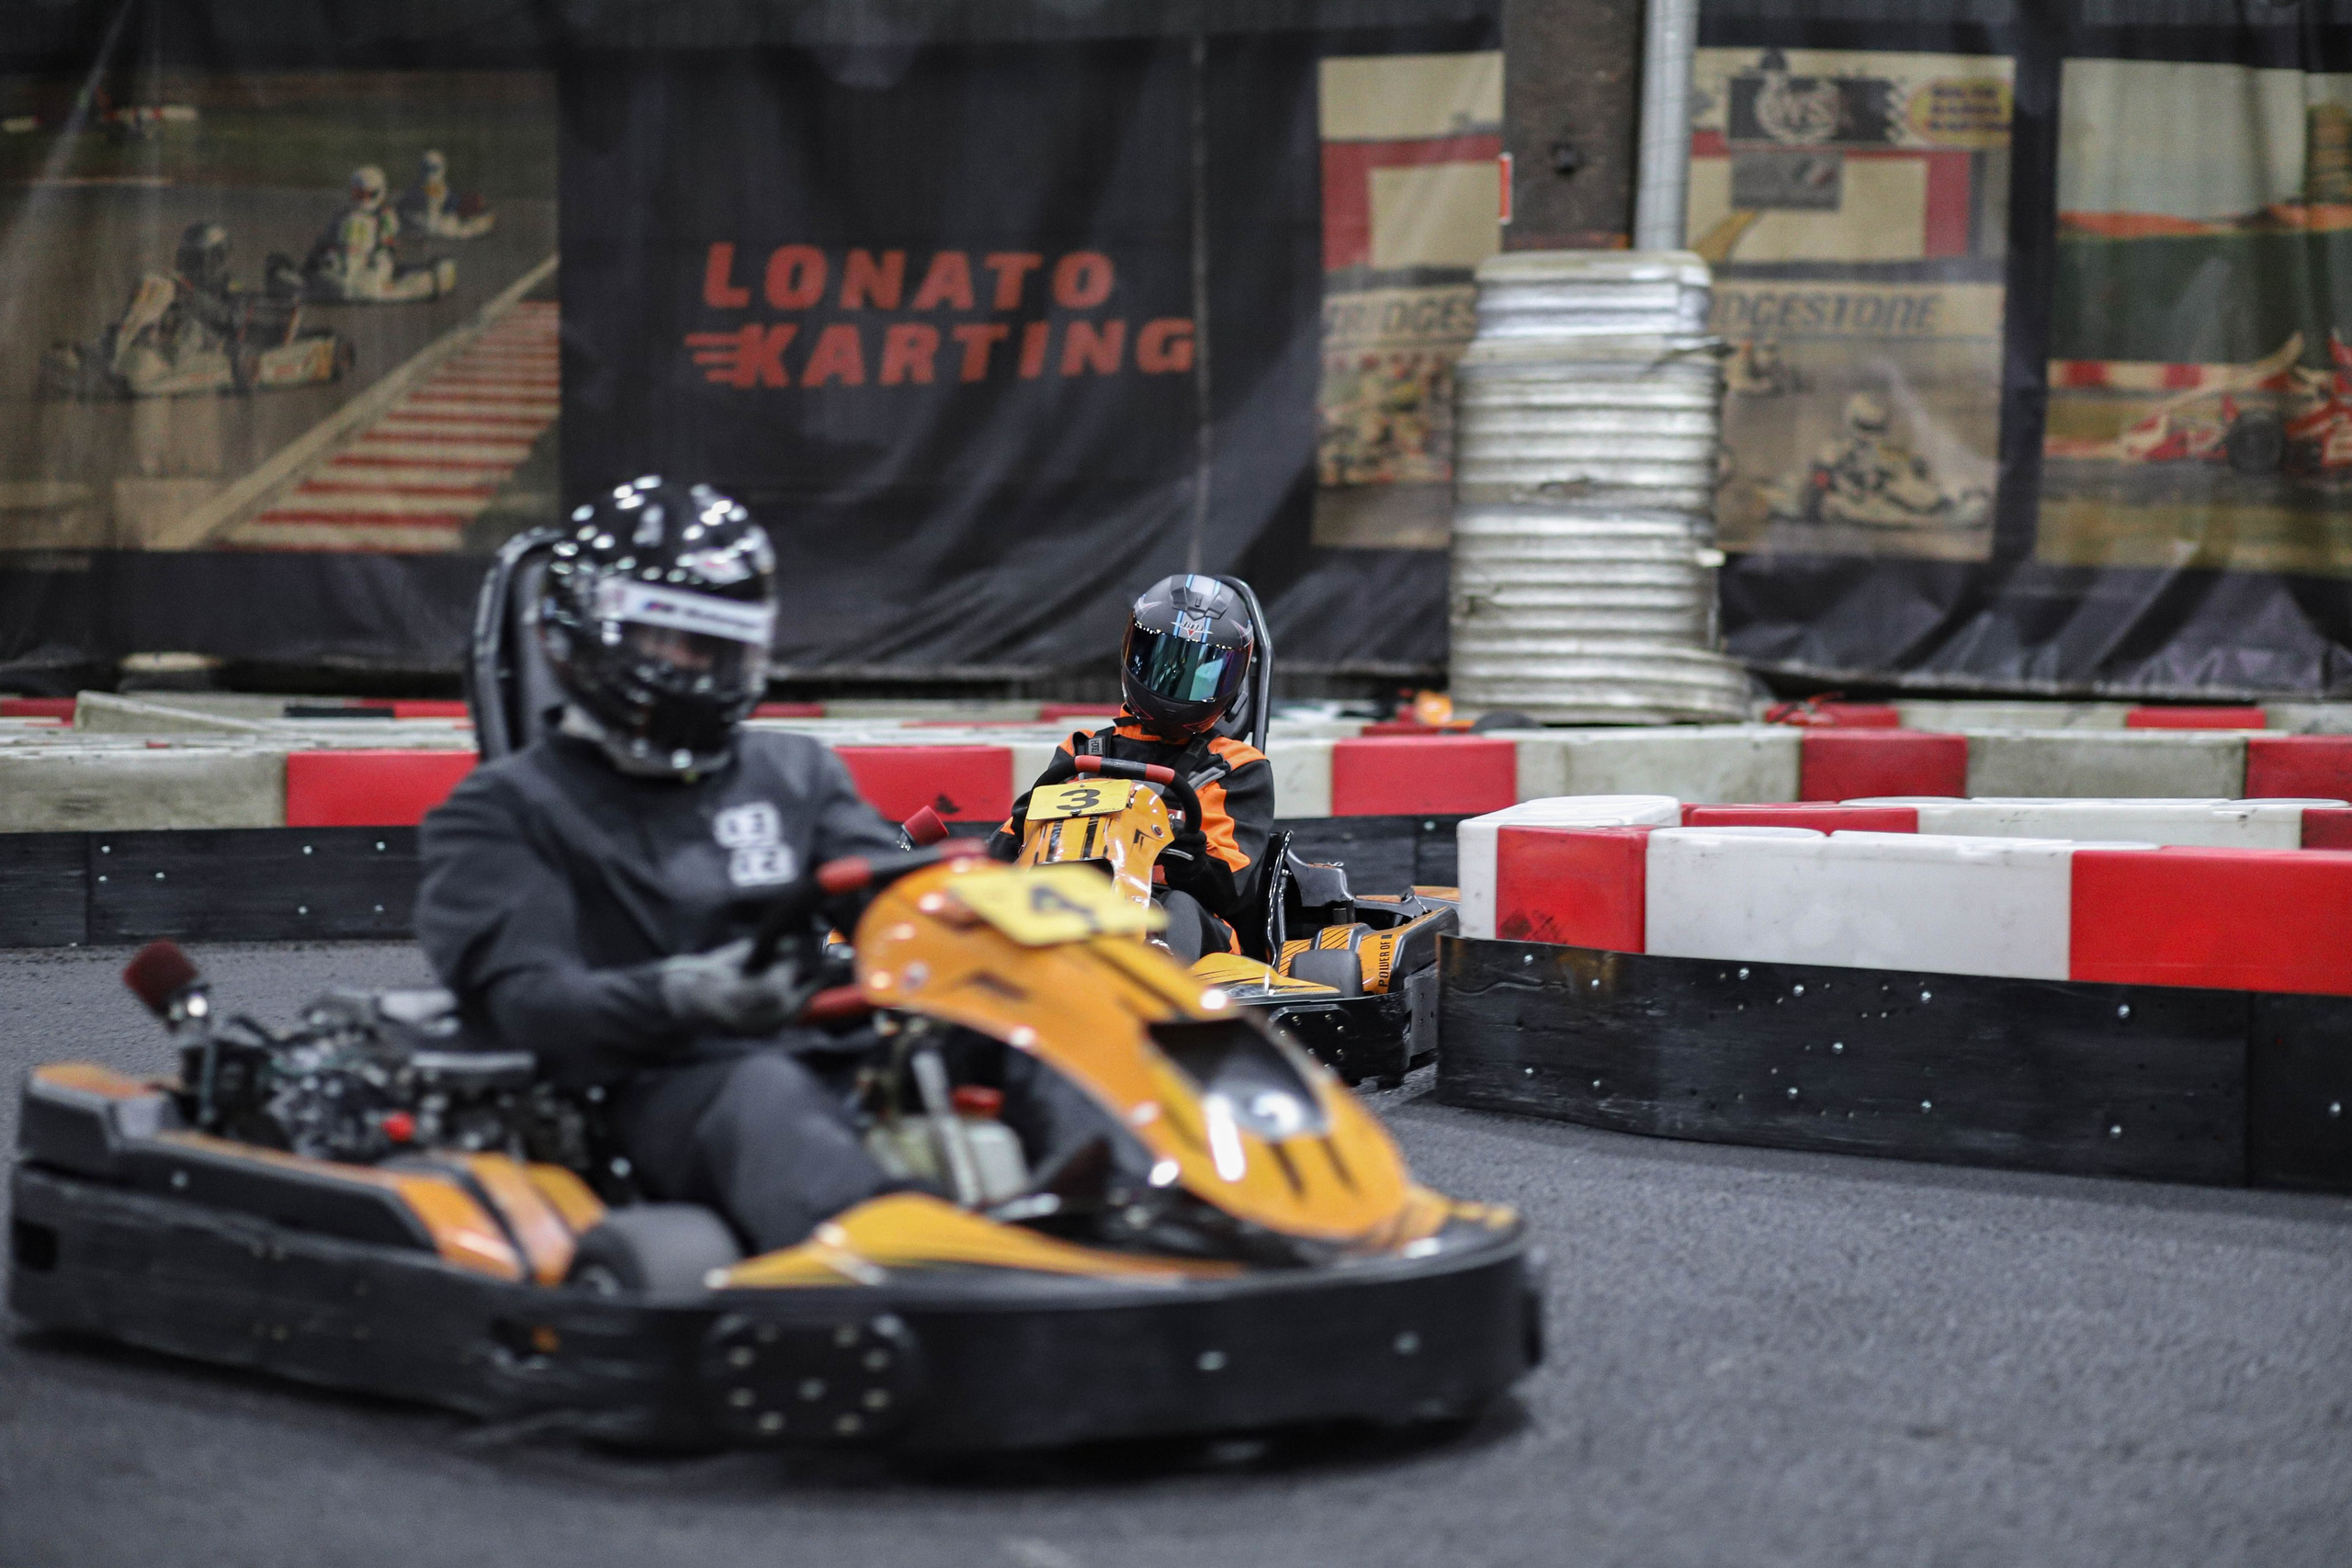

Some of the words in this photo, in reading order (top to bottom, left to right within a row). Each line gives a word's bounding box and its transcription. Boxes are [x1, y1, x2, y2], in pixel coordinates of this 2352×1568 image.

[703, 242, 1114, 310] LONATO
[1711, 291, 1943, 333] DGESTONE
[732, 318, 1196, 388] KARTING
[1056, 788, 1101, 811] 3
[1380, 942, 1391, 950] OF
[1378, 952, 1390, 987] POWER
